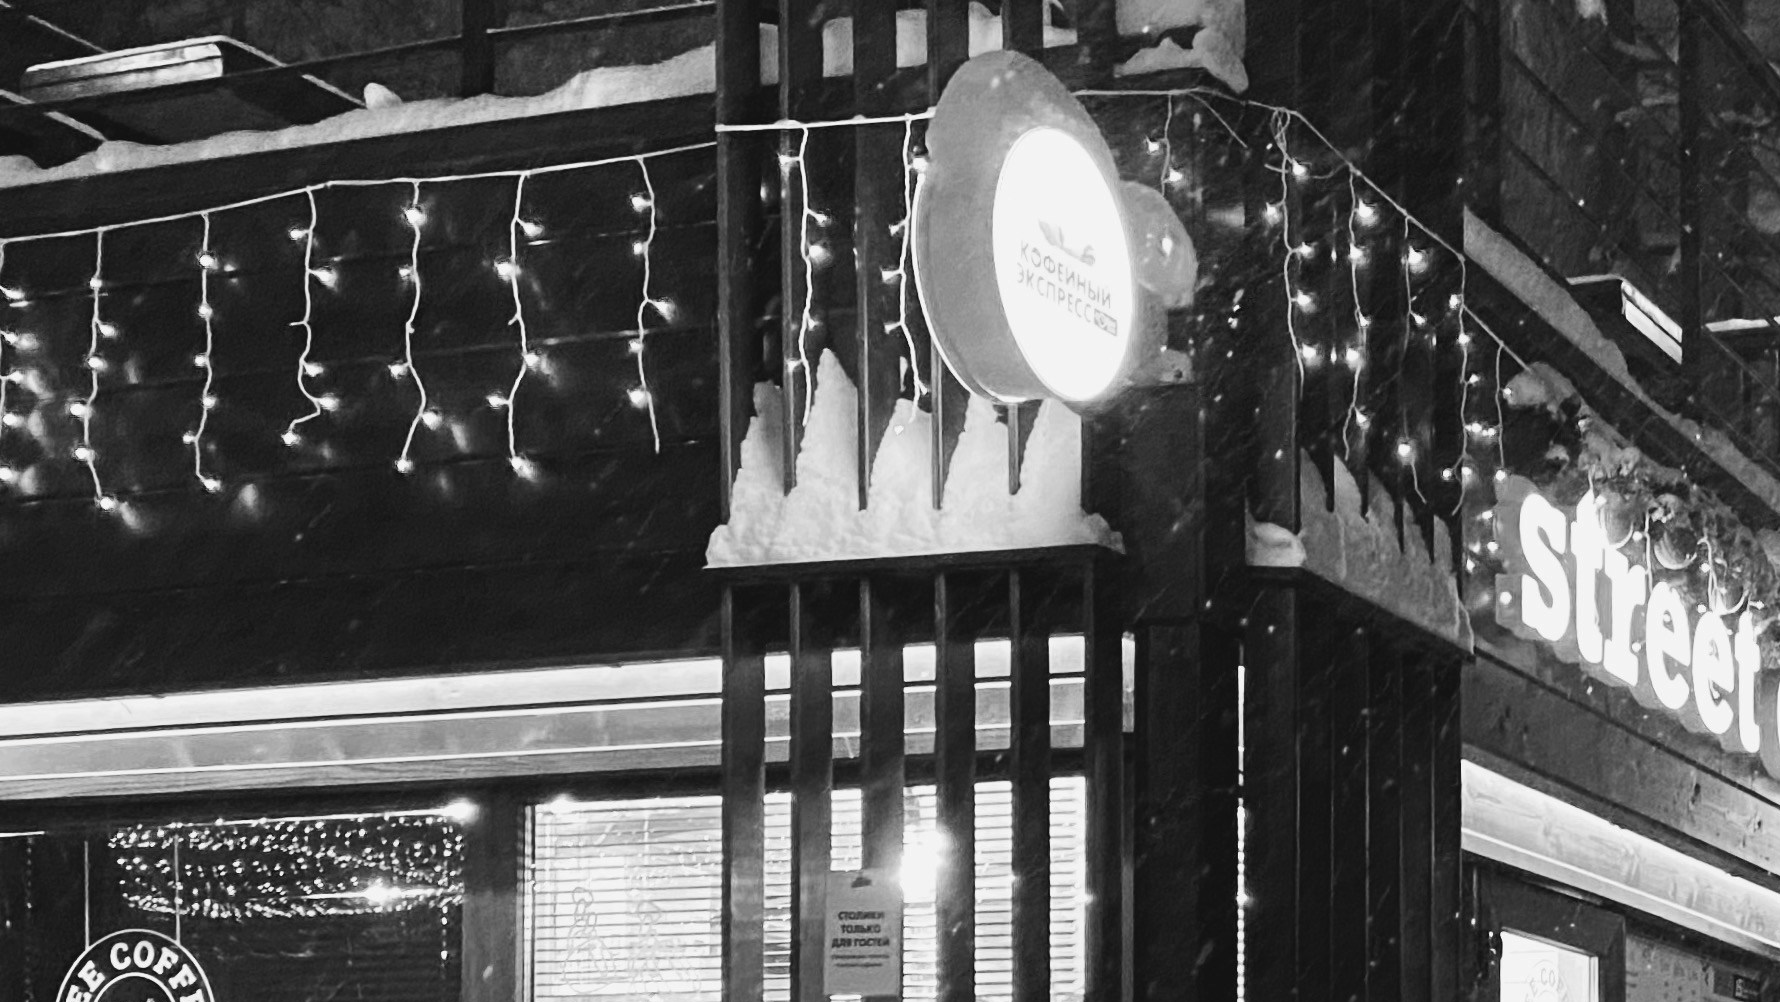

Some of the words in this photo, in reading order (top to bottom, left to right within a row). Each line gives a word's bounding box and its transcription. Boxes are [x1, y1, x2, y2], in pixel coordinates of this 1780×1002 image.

[1017, 262, 1092, 323] ЭКСПРЕСС
[837, 911, 885, 921] СТОЛИКИ
[841, 924, 882, 934] ТОЛЬКО
[831, 937, 852, 948] ДЛЯ
